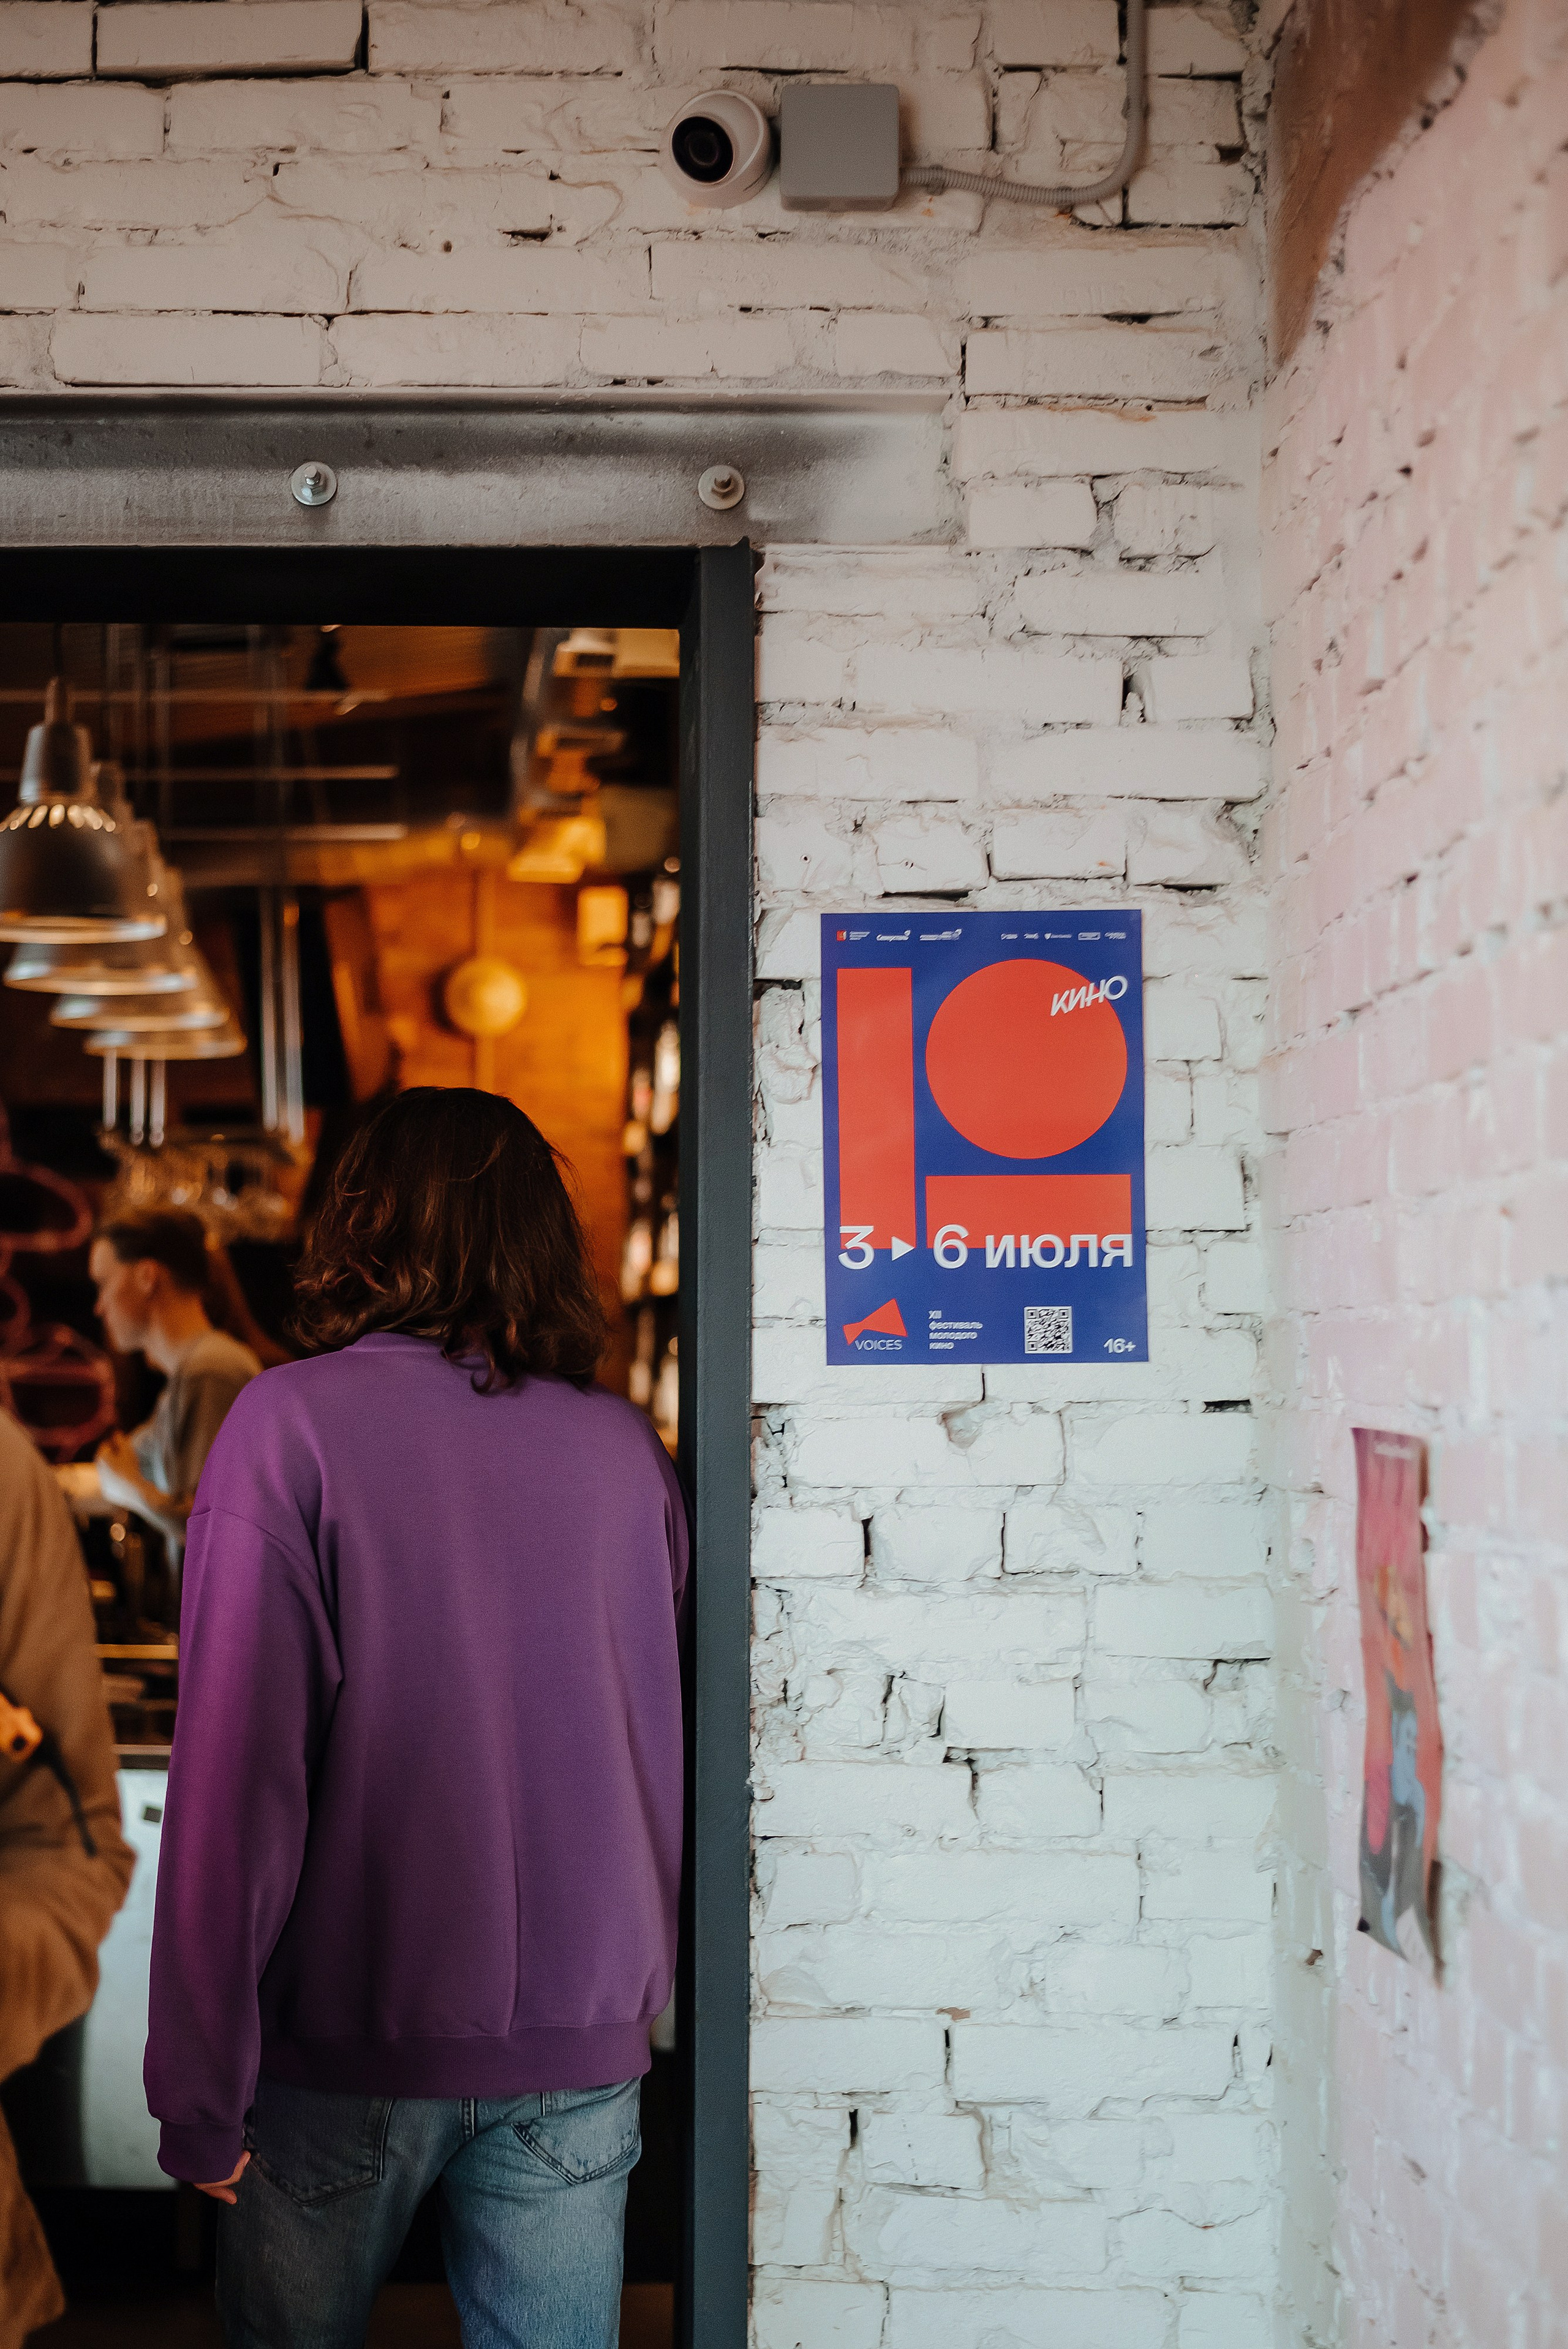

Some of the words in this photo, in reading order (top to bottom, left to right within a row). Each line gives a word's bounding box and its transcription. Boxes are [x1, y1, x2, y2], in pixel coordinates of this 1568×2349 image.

[1050, 976, 1128, 1016] КИНО
[839, 1225, 875, 1270] 3
[933, 1224, 968, 1269] 6
[986, 1234, 1133, 1269] июля
[929, 1321, 983, 1331] фестиваль
[929, 1332, 978, 1340] молодого
[854, 1340, 903, 1351] VOICES
[1103, 1338, 1136, 1354] 16+
